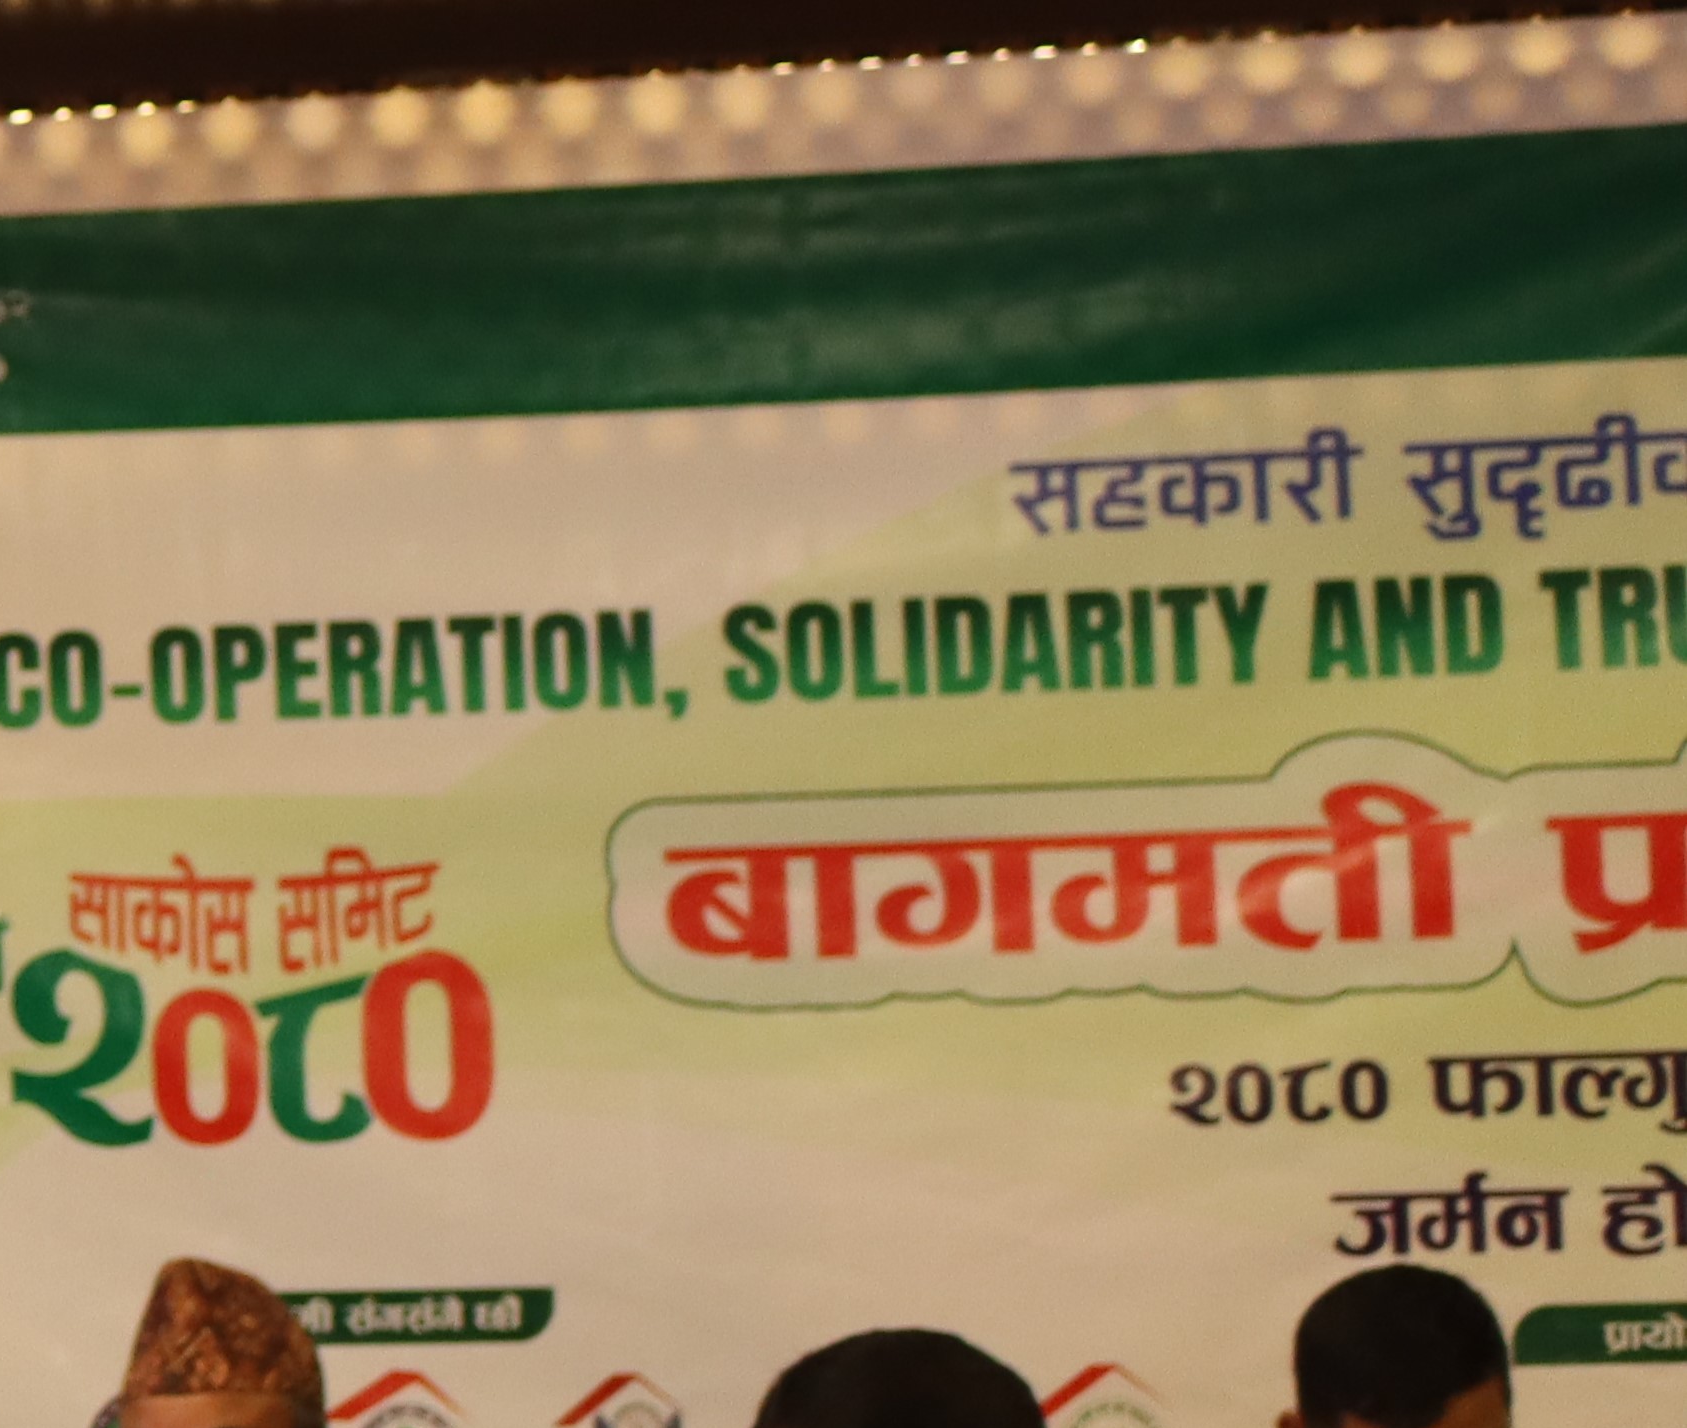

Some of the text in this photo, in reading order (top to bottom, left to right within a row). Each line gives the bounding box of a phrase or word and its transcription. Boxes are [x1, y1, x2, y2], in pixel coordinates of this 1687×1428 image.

[1009, 427, 1364, 535] सहकारी
[722, 582, 1269, 704] SOLIDARITY
[1307, 572, 1504, 682] AND
[68, 845, 441, 974] साकोस समिट
[664, 781, 1473, 961] बागमती
[10, 948, 495, 1147] २०८०
[1169, 1059, 1390, 1126] २०८०
[1329, 1171, 1570, 1256] जर्मन
